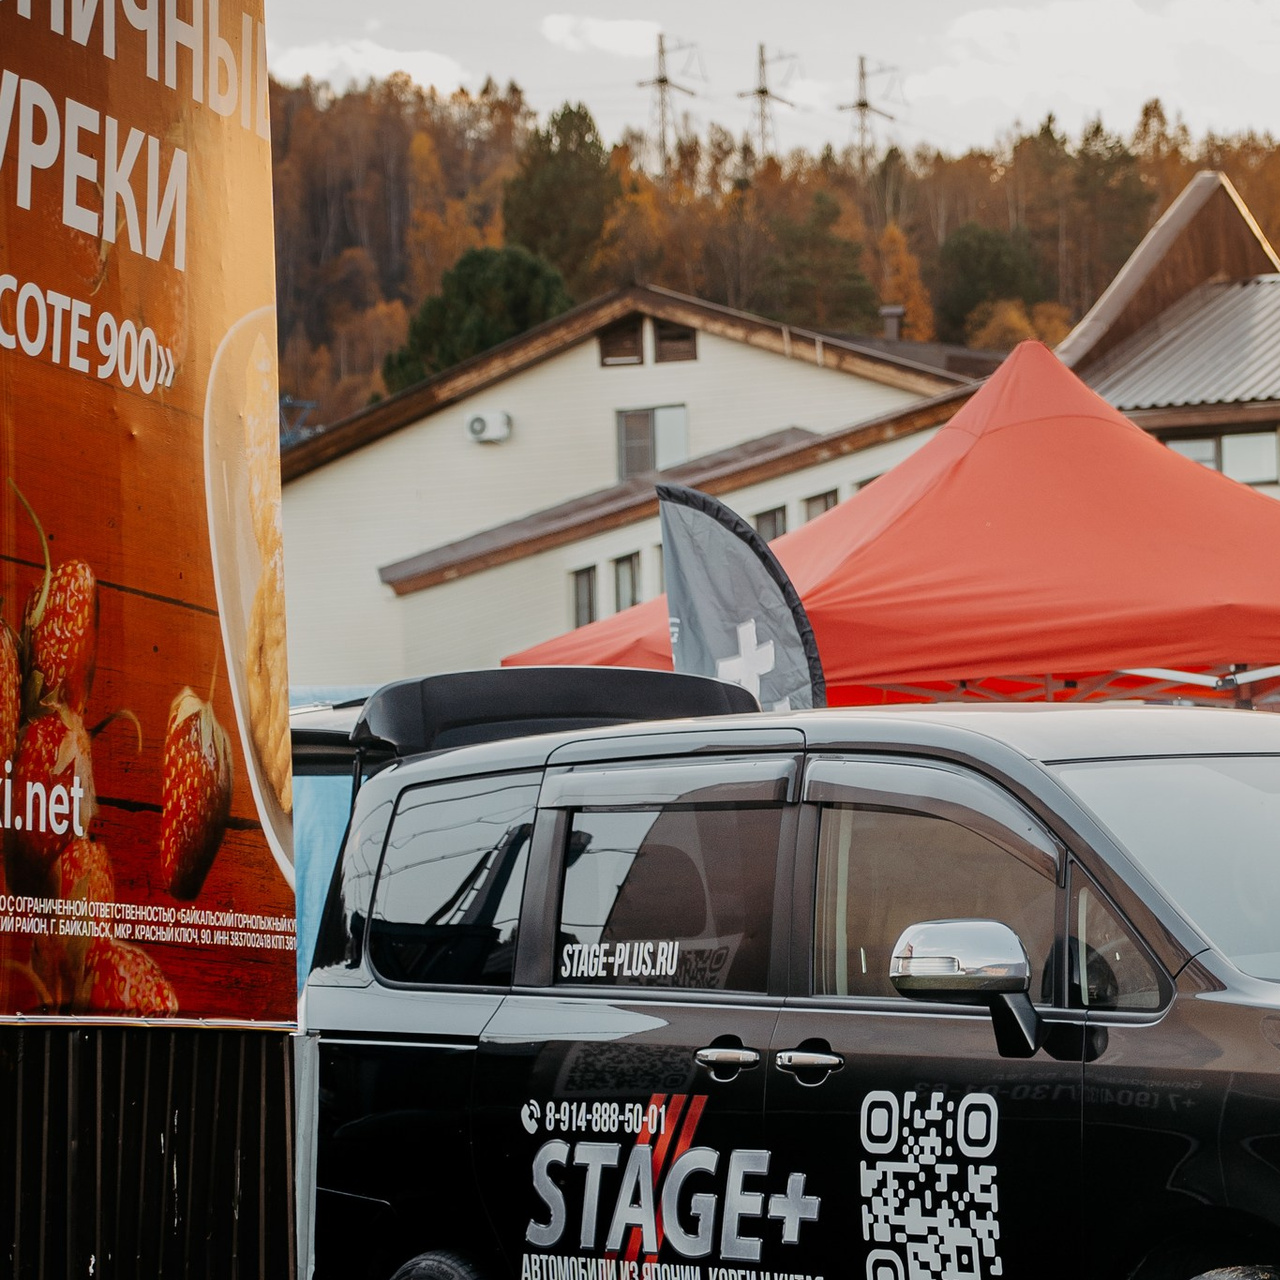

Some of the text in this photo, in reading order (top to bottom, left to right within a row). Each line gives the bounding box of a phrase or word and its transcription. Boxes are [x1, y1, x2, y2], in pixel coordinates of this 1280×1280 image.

[96, 311, 176, 395] 900»
[0, 760, 84, 837] i.net
[15, 896, 88, 917] ОГРАНИЧЕННОЙ
[89, 901, 176, 923] ОТВЕТСТВЕННОСТЬЮ
[15, 913, 49, 937] РАЙОН,
[50, 919, 58, 935] Г.
[59, 916, 113, 940] БАЙКАЛЬСК,
[114, 922, 134, 939] МКР.
[135, 923, 173, 943] КРАСНЫЙ
[174, 927, 200, 946] КЛЮЧ,
[200, 929, 213, 945] 90.
[213, 930, 229, 946] ИНН
[561, 941, 680, 978] STAGE-PLUS.RU
[545, 1101, 667, 1135] 8-914-888-50-01
[525, 1138, 822, 1263] STAGE+
